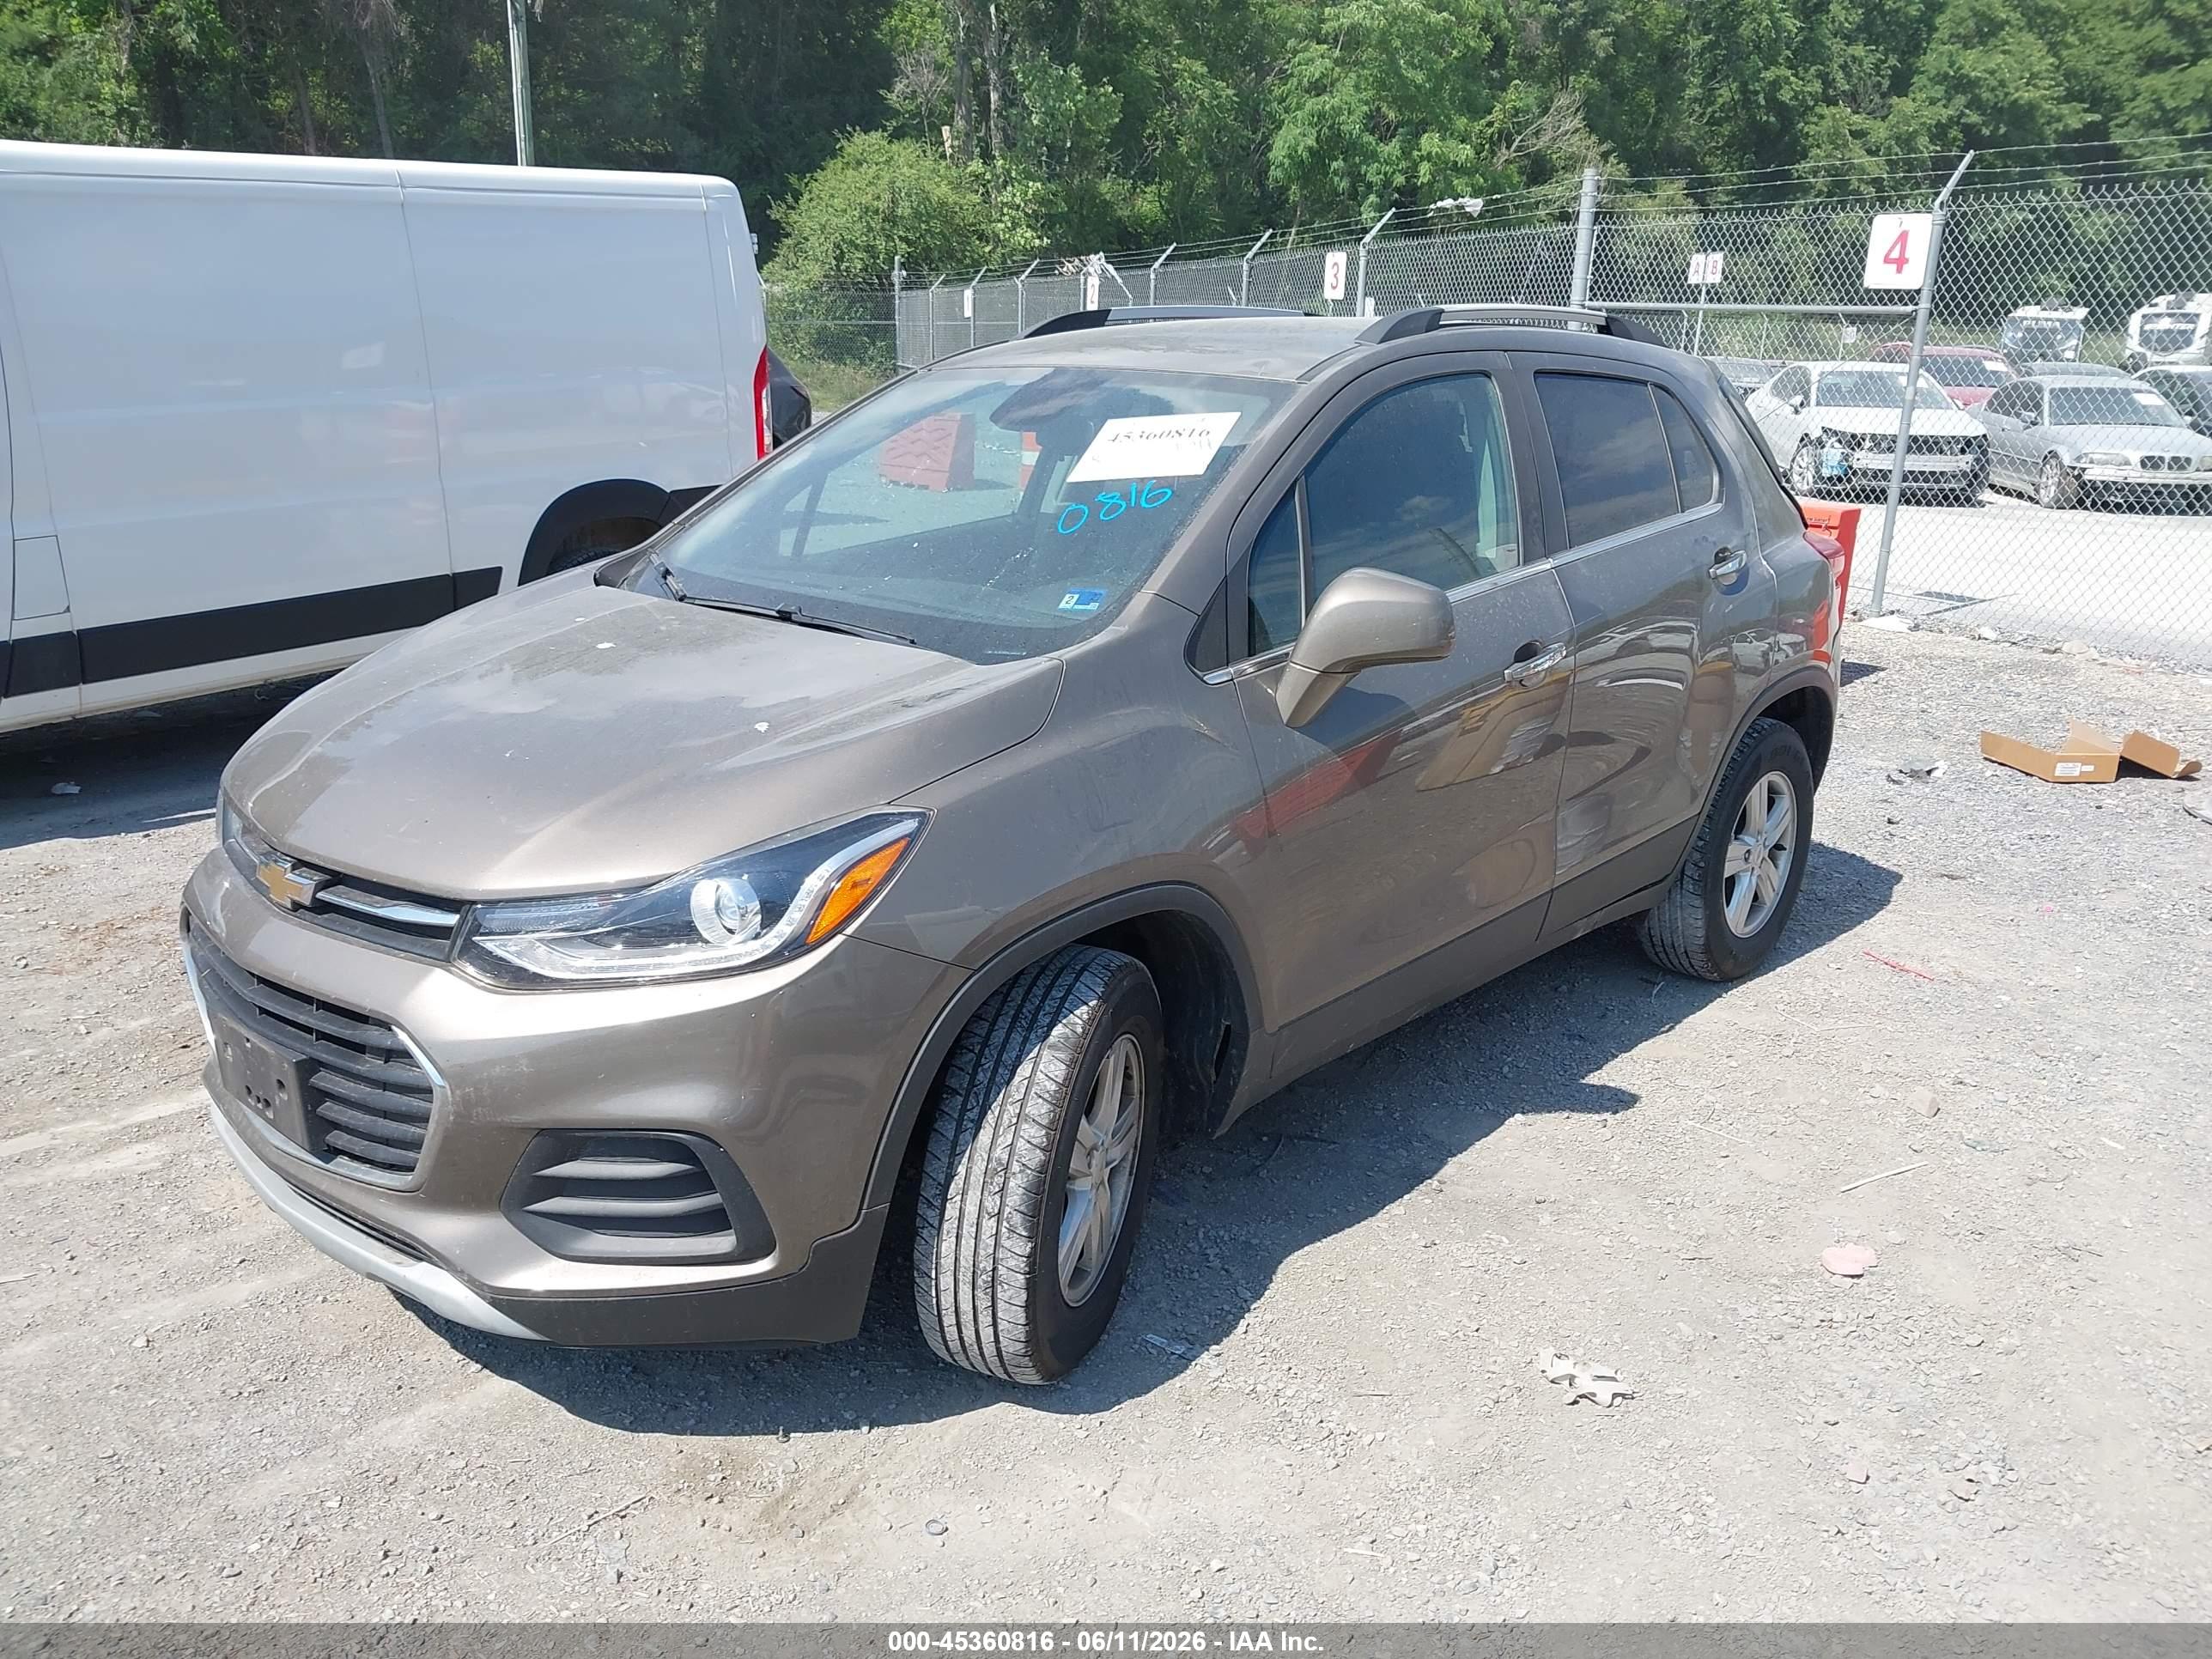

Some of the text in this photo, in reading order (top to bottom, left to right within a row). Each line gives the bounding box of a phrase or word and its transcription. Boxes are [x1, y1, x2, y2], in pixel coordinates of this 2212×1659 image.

[1883, 229, 1910, 274] 4
[1331, 262, 1340, 290] 3
[1692, 259, 1718, 276] A B
[1091, 283, 1096, 304] 2
[1057, 480, 1173, 534] 0816
